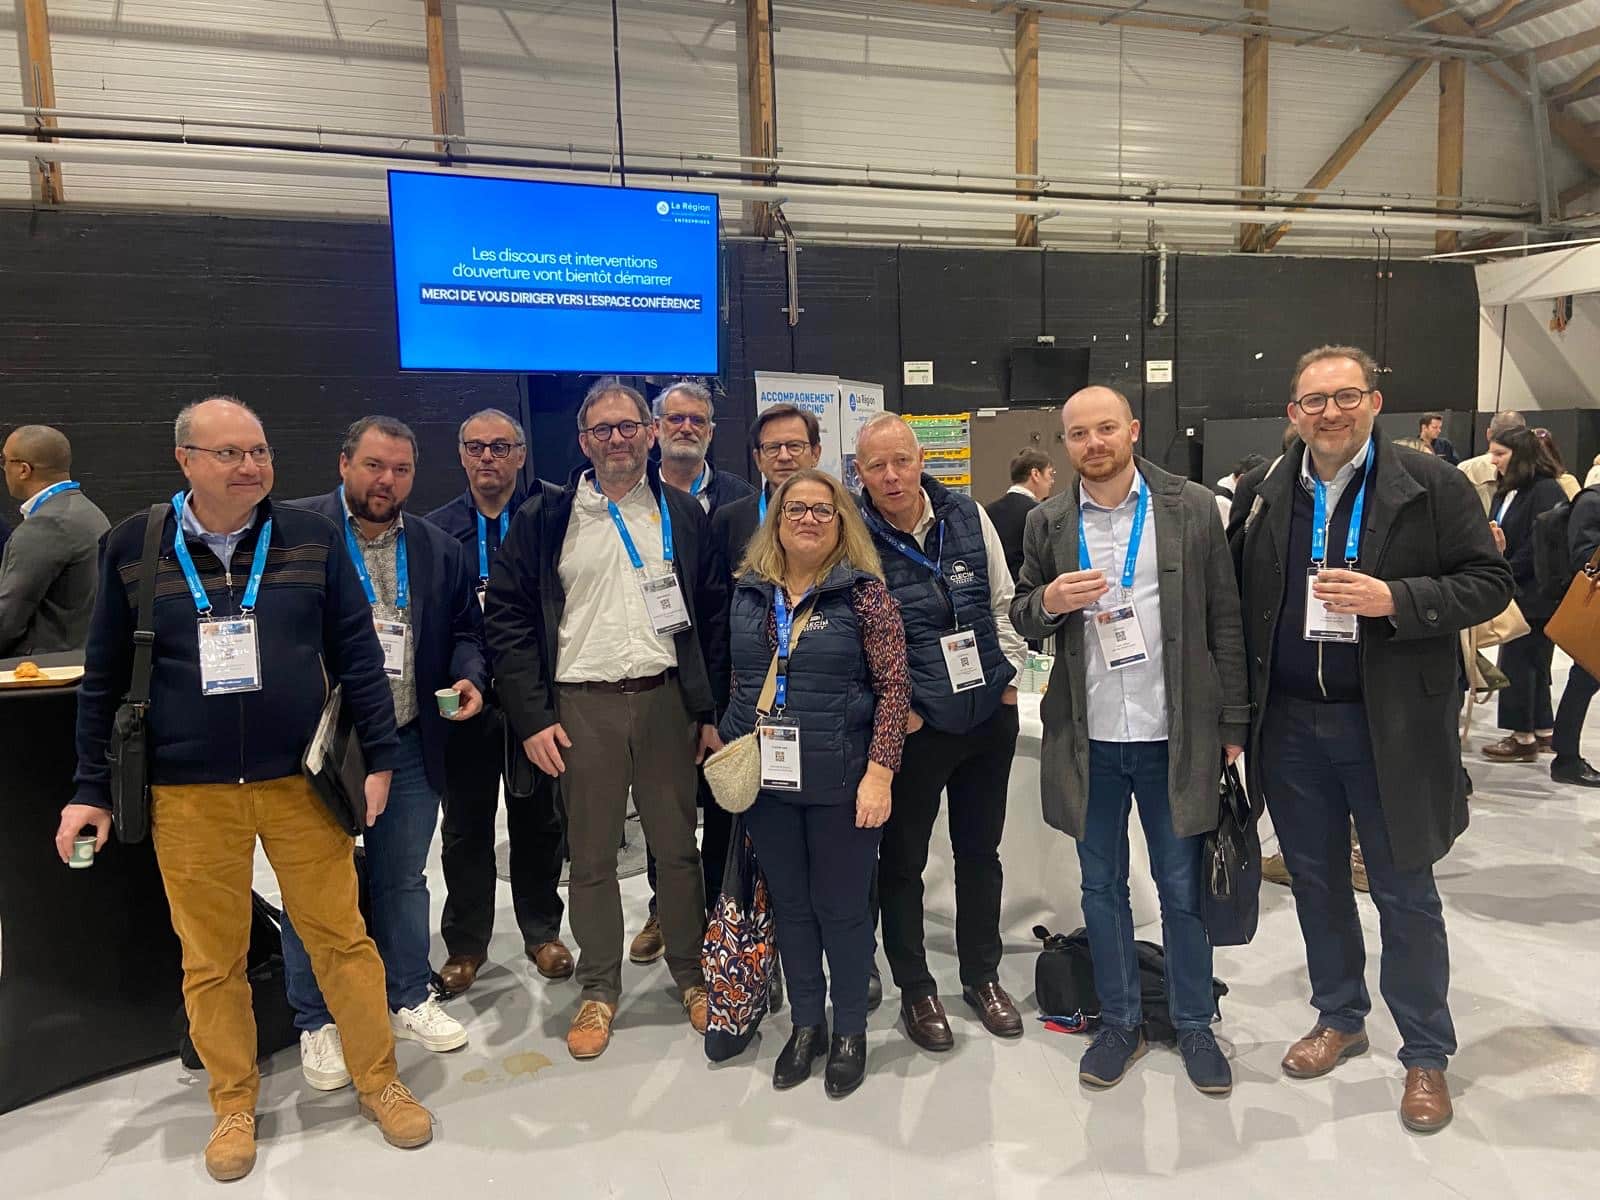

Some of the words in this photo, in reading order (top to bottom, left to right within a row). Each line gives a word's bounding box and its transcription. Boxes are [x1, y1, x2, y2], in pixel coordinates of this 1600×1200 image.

[671, 202, 680, 210] La
[682, 202, 711, 212] Région
[472, 246, 497, 262] Les
[499, 248, 557, 264] discours
[559, 252, 573, 265] et
[575, 252, 658, 269] interventions
[452, 262, 531, 281] d'ouverture
[533, 269, 563, 282] vont
[565, 268, 612, 284] bientôt
[614, 269, 673, 287] démarrer
[421, 287, 459, 301] MERCI
[460, 289, 477, 301] DE
[477, 290, 510, 303] VOUS
[511, 291, 555, 304] DIRIGER
[555, 293, 584, 305] VERS
[584, 294, 631, 307] L'ESPACE
[631, 295, 701, 310] CONFÉRENCE
[760, 391, 834, 403] ACCOMPAGNEMENT
